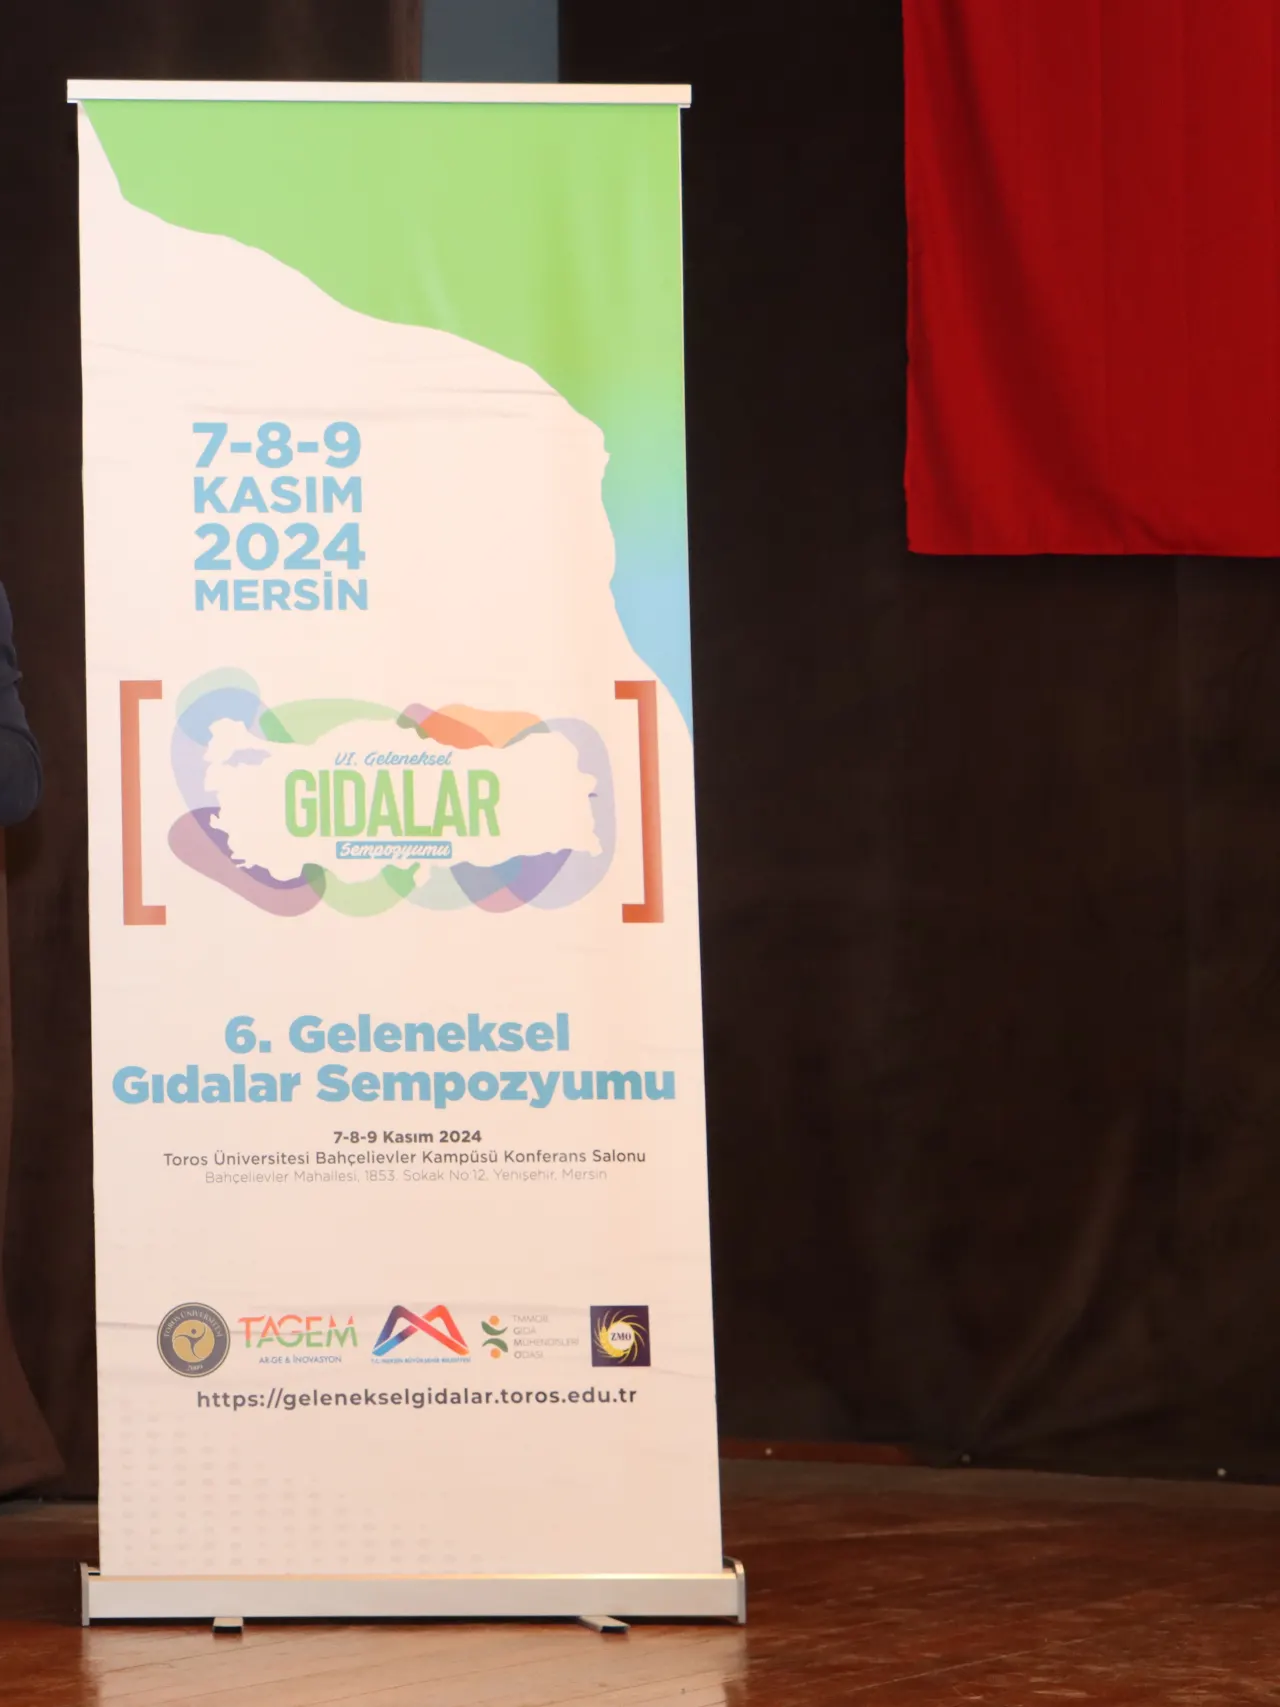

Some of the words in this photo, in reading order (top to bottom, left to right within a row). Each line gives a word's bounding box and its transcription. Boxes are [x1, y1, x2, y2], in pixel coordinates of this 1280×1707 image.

[192, 422, 362, 468] 7-8-9
[193, 476, 363, 513] KASIM
[194, 523, 366, 571] 2024
[194, 571, 368, 611] MERSİN
[363, 751, 453, 766] Geleneksel
[285, 769, 500, 838] GIDALAR
[339, 841, 451, 859] Sempozyumu
[224, 1015, 272, 1054] 6.
[288, 1013, 570, 1053] Geleneksel
[112, 1064, 301, 1104] Gıdalar
[316, 1064, 676, 1109] Sempozyumu
[333, 1131, 378, 1144] 7-8-9
[383, 1130, 434, 1144] Kasım
[439, 1130, 483, 1143] 2024
[163, 1153, 209, 1167] Toros
[213, 1149, 310, 1166] Üniversitesi
[315, 1150, 416, 1168] Bahçelievler
[422, 1149, 499, 1166] Kampüsü
[504, 1149, 587, 1163] Konferans
[592, 1149, 646, 1163] Salonu
[205, 1170, 289, 1185] Bahçelievler
[403, 1169, 444, 1182] Sokak
[562, 1167, 608, 1181] Mersin
[238, 1314, 359, 1349] TAGEM
[610, 1332, 632, 1342] ZMO
[196, 1386, 638, 1411] https://gelenekselgidalar.toros.edu.tr
